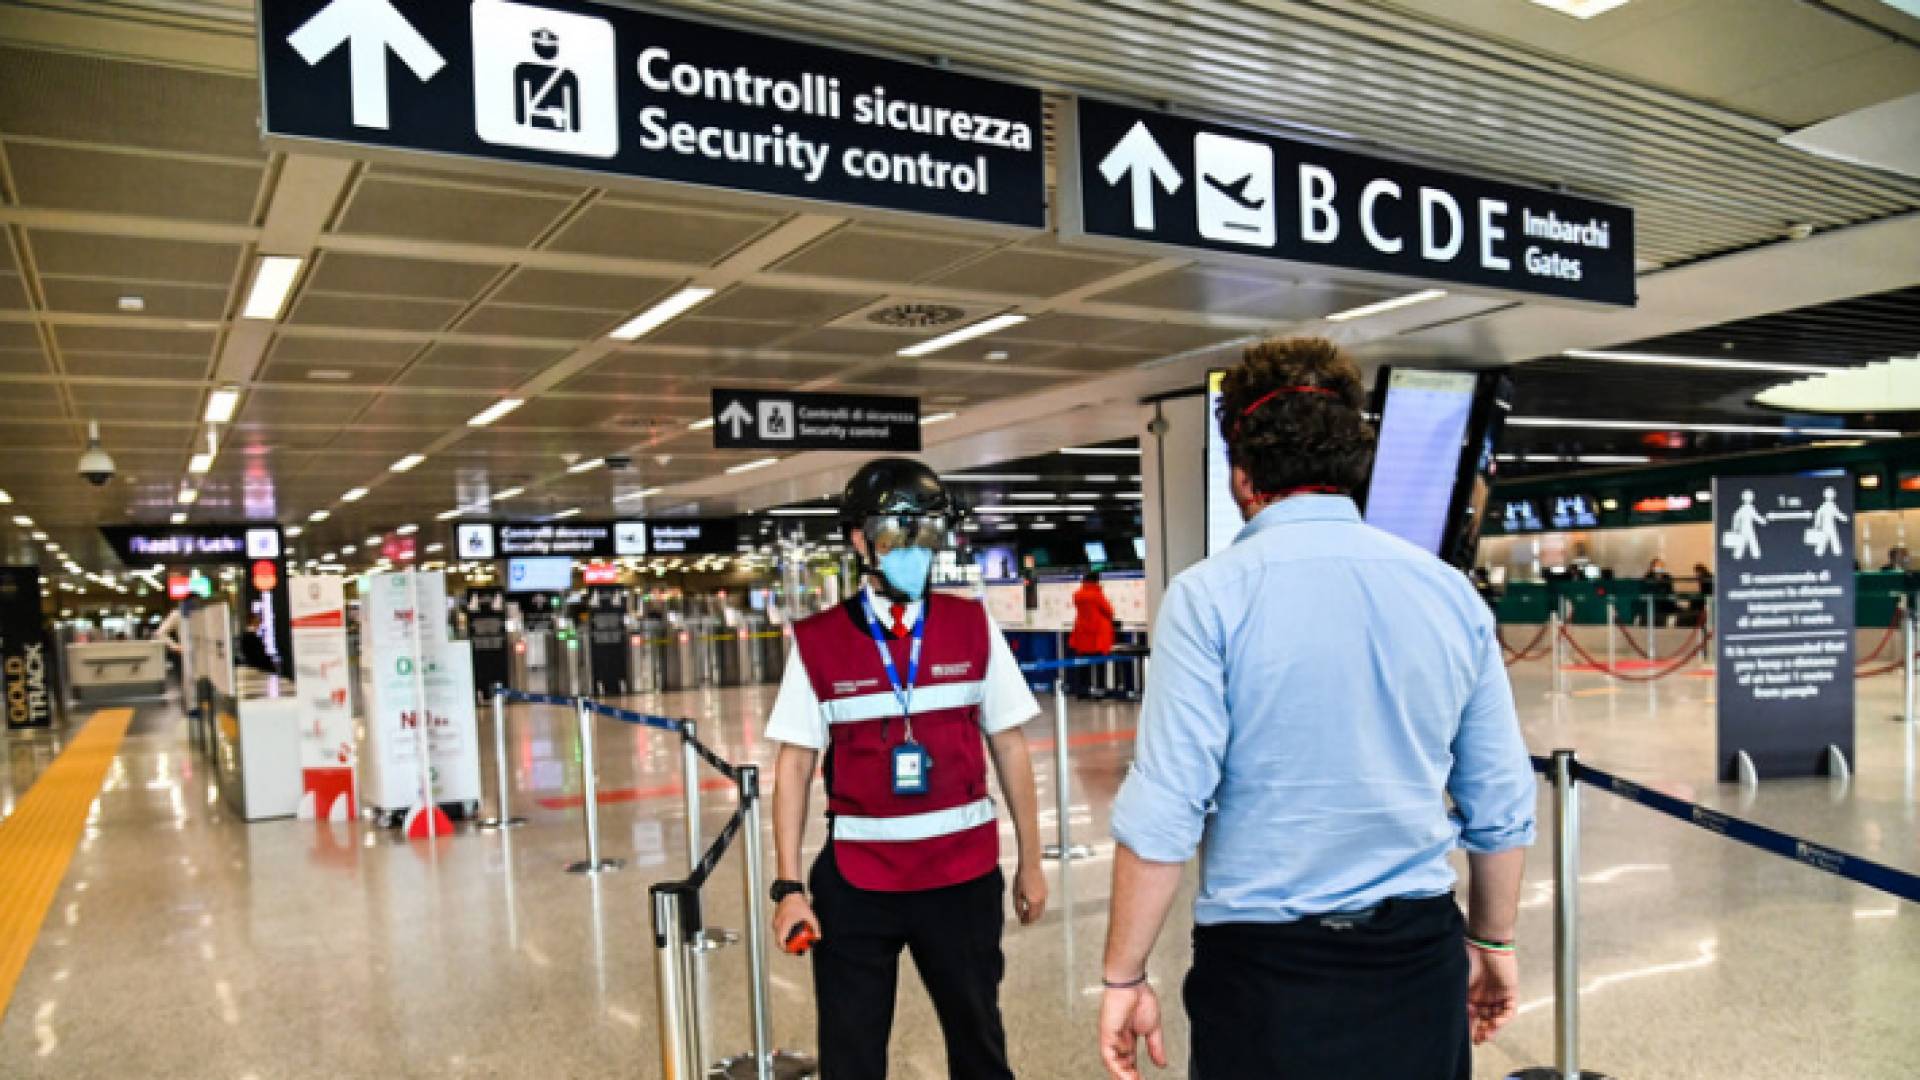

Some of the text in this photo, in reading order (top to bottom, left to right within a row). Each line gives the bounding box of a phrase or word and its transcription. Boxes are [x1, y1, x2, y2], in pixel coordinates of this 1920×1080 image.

[636, 46, 1032, 151] Controlli sicurezza
[639, 106, 989, 195] Security control
[1299, 162, 1512, 270] B C D E
[1522, 207, 1610, 249] Imbarchi
[1524, 246, 1583, 281] Gates
